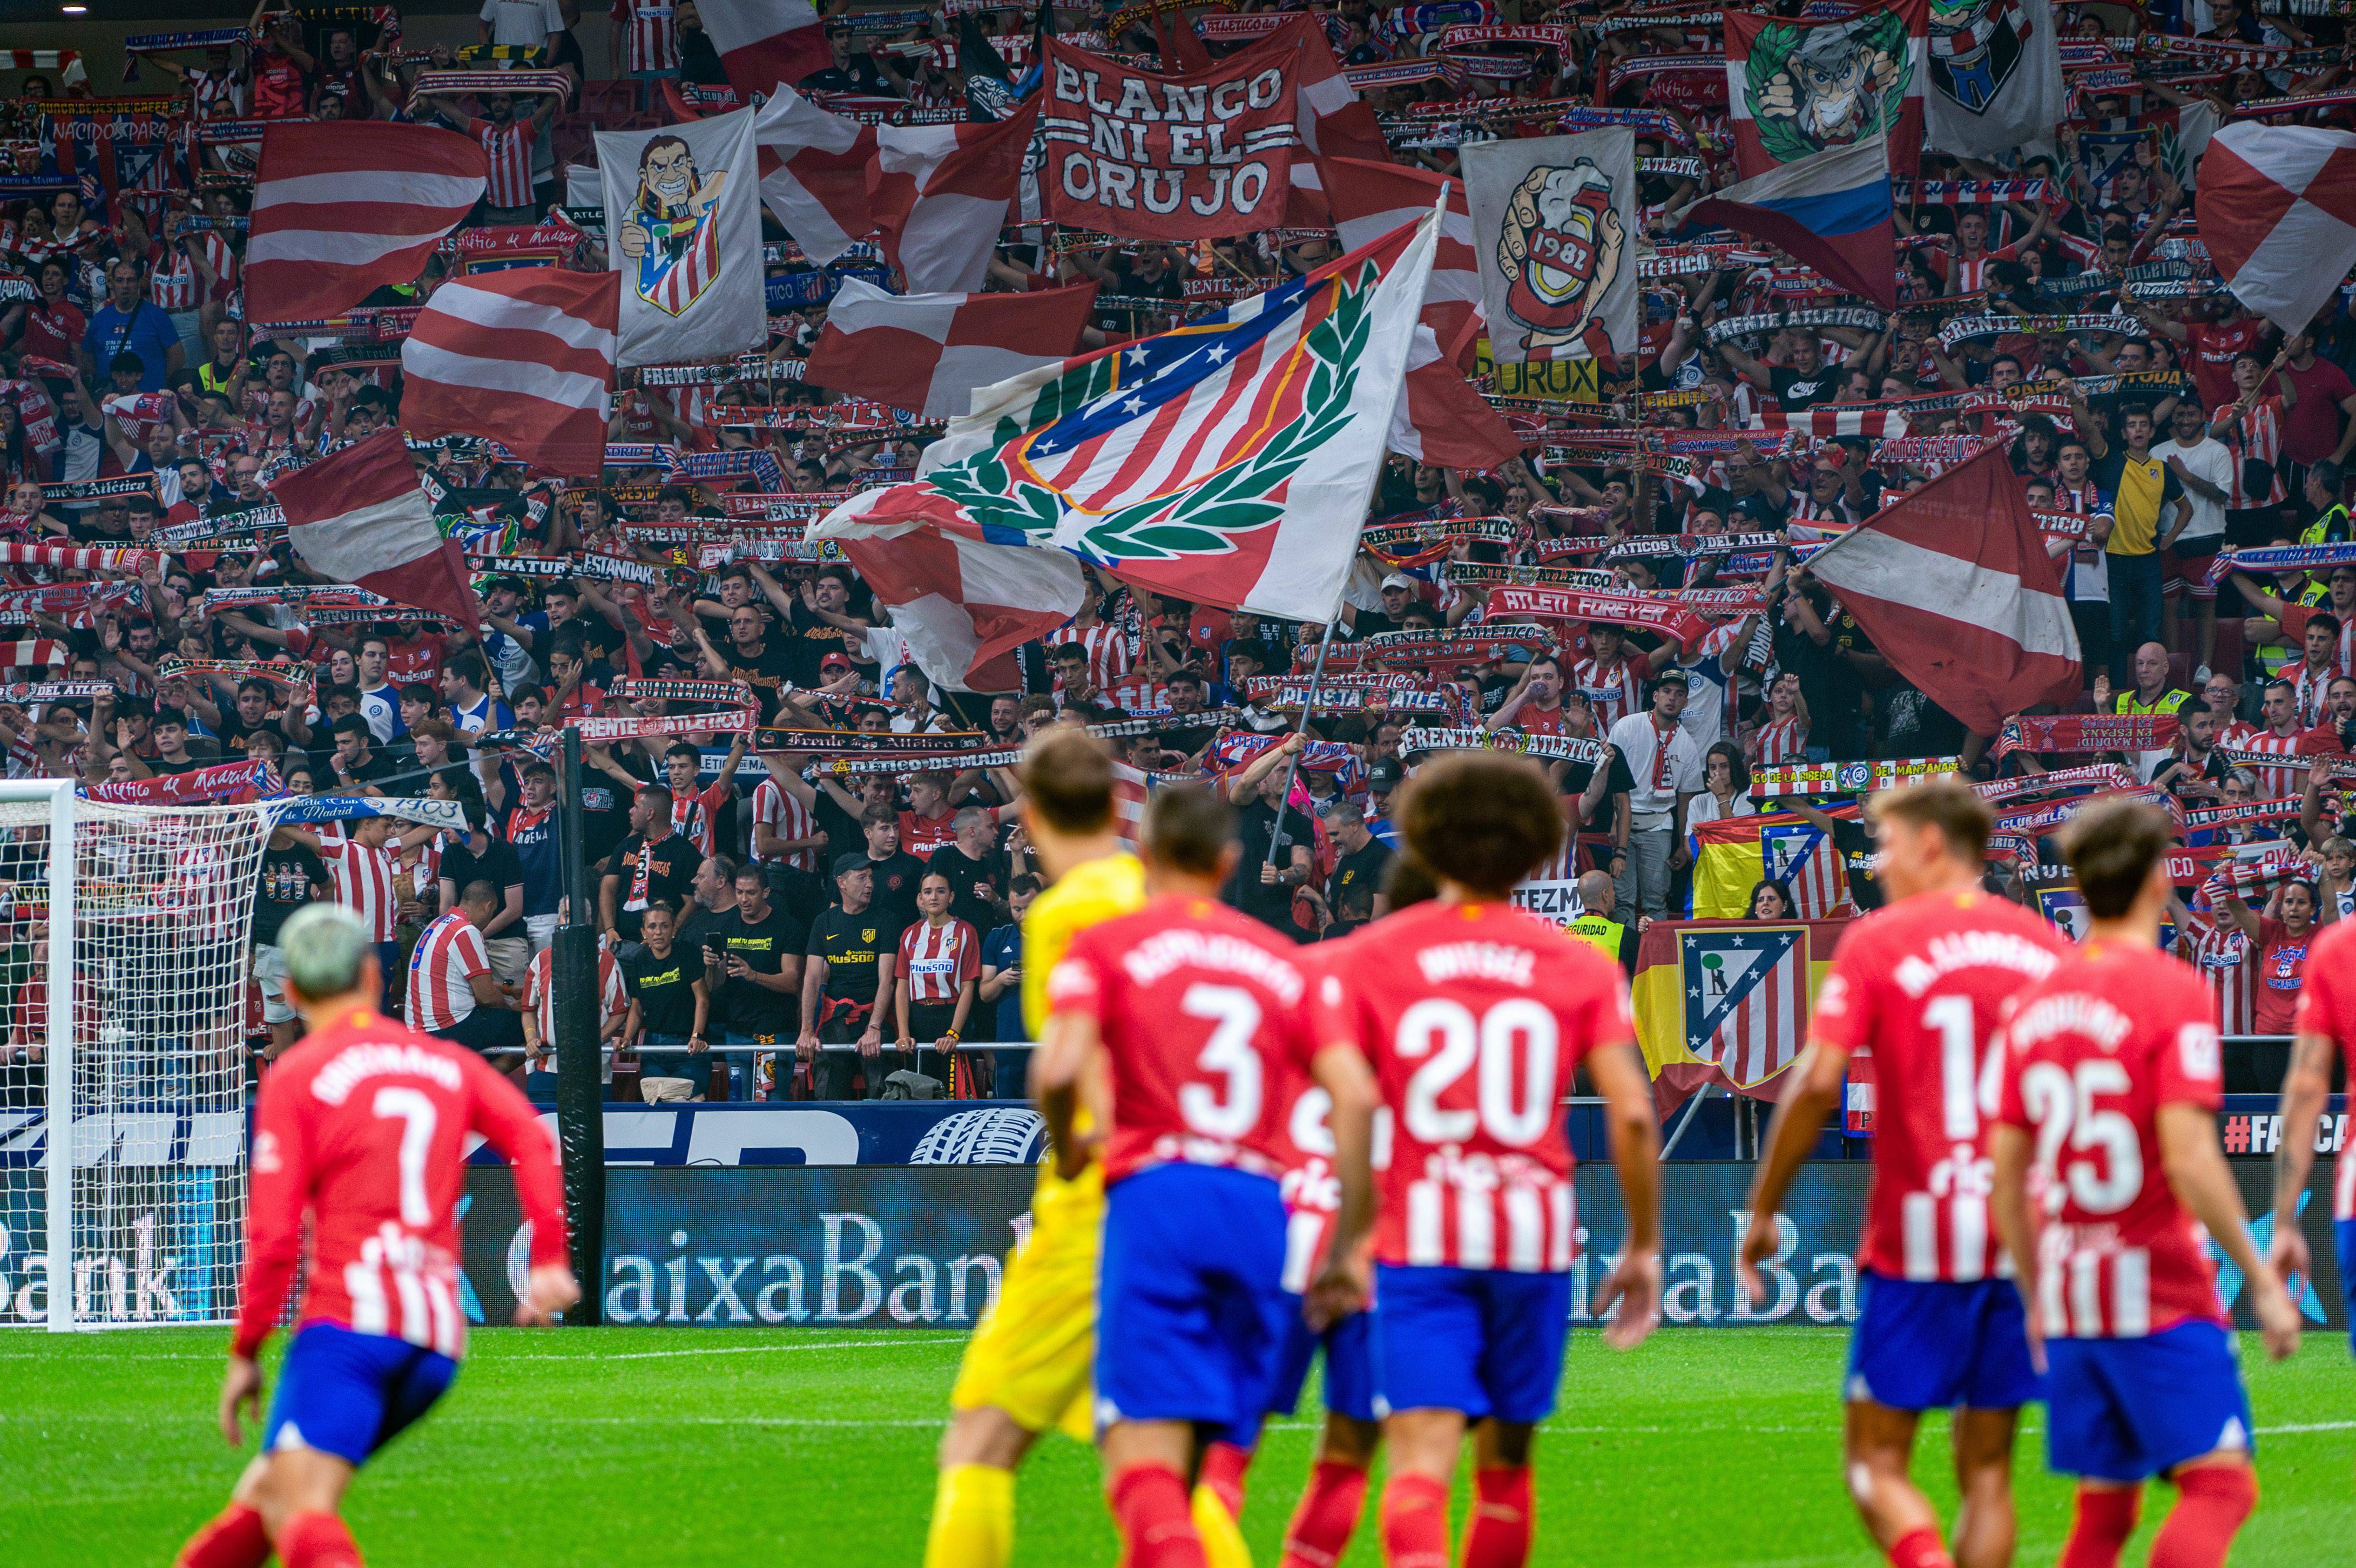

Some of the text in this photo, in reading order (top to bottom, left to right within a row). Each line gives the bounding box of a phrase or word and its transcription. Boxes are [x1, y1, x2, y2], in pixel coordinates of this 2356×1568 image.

[1207, 18, 1259, 33] ATLETICO
[1446, 26, 1562, 42] FRENTE ATLETI
[1368, 64, 1430, 81] DE MADRID
[703, 91, 723, 102] CLUB
[1054, 56, 1282, 122] BLANCO
[1703, 84, 1717, 98] de
[39, 102, 168, 114] NUNCA DEJES DE CREER
[912, 107, 967, 122] MUERTE
[54, 121, 112, 140] NACIDO
[129, 121, 167, 139] PARA
[1091, 113, 1243, 166] NI EL
[1063, 151, 1269, 217] ORUJO
[506, 229, 578, 245] de Madrid
[1062, 233, 1108, 248] ESCUDO
[1533, 231, 1588, 270] 1982
[2130, 282, 2186, 298] Frente
[1711, 307, 1884, 343] FRENTE ATLETICO
[1940, 315, 2142, 342] FRENTE ATLETICO
[644, 366, 706, 387] FRENTE
[2127, 371, 2181, 387] TODA
[1794, 382, 1819, 395] NIKE
[1645, 391, 1709, 408] FRENTE
[1882, 440, 1920, 459] VAMOS
[1922, 438, 1958, 458] ATLETI
[1651, 456, 1692, 475] TODOS
[89, 478, 146, 497] Atlético
[735, 496, 750, 508] EL
[164, 518, 214, 540] SIEMPRE
[625, 524, 717, 543] FRENTE
[1444, 518, 1518, 538] ATLÉTICO
[96, 539, 258, 550] FRENTE ATLETICO
[1538, 536, 1609, 555] FRENTE
[1707, 532, 1777, 549] DEL ATLE
[1449, 564, 1612, 589] FRENTE ATLETICO
[6, 582, 127, 600] ATLETICO DE MADRID
[1677, 587, 1747, 604] ATLETICO
[1507, 590, 1669, 622] ATLETI FOREVER
[1260, 624, 1270, 632] EL
[1371, 626, 1536, 654] FRENTE ATLETICO
[388, 669, 436, 685] Plus500
[38, 684, 61, 696] DEL
[605, 680, 738, 701] NO SURRENDER
[578, 710, 746, 739] FRENTE ATLETICO
[2136, 728, 2154, 738] EN
[786, 731, 846, 749] Frente
[1404, 727, 1604, 763] FRENTE ATLETICO
[96, 761, 254, 800] Atlético de Madrid
[1769, 772, 1781, 783] DE
[1783, 772, 1796, 782] LA
[1799, 770, 1832, 782] RIBERA
[1875, 766, 1893, 778] DEL
[1824, 781, 1831, 792] 9
[1881, 777, 1888, 787] 0
[326, 797, 359, 806] Club
[395, 797, 458, 814] 1903
[285, 806, 354, 820] de Madrid
[2000, 816, 2034, 832] CLUB
[827, 954, 875, 964] Plus500
[911, 963, 953, 973] Plus500
[2267, 977, 2303, 990] DE MADRID
[1179, 982, 1263, 1141] 3
[1395, 997, 1560, 1148] 20
[2020, 1060, 2144, 1215] 25
[373, 1086, 439, 1227] 7
